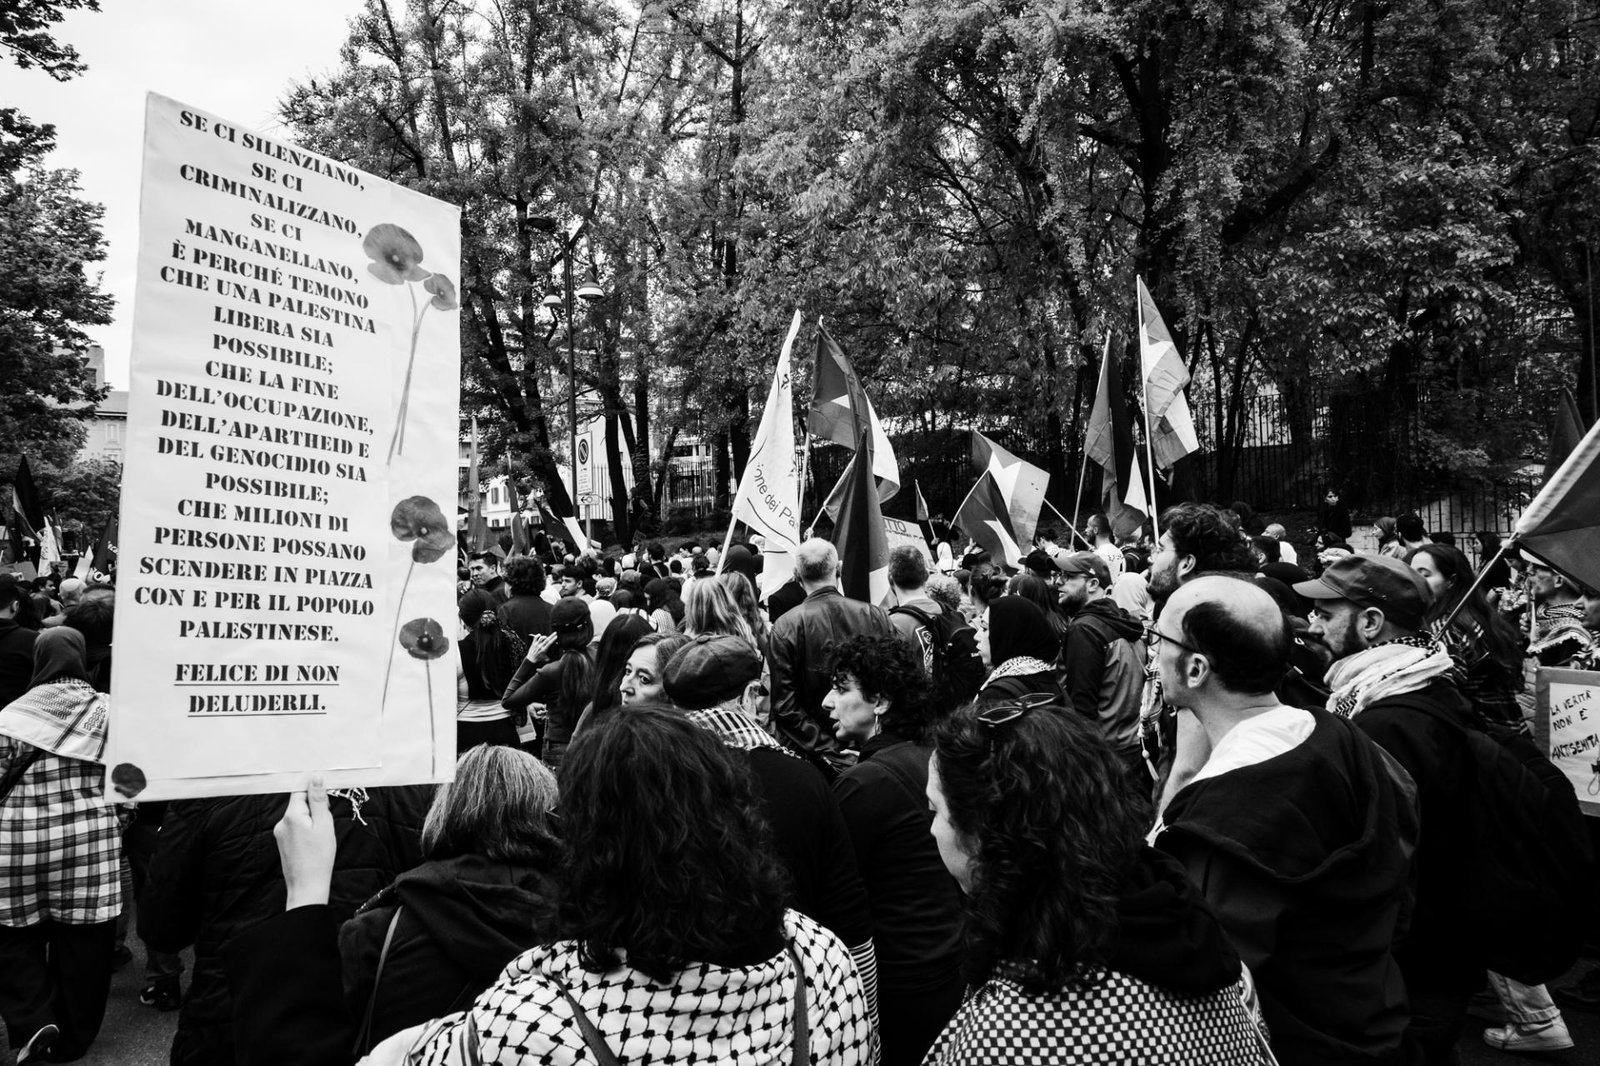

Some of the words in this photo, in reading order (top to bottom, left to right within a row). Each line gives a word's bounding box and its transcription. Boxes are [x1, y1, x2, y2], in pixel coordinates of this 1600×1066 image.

[180, 110, 207, 132] SE
[214, 123, 235, 143] CI
[242, 133, 364, 191] SILENZIANO,
[252, 162, 276, 183] SE
[282, 174, 302, 192] CI
[179, 163, 362, 239] CRIMINALIZZANO,
[251, 213, 275, 233] SE
[282, 224, 301, 241] CI
[186, 219, 358, 284] MANGANELLANO,
[172, 238, 185, 260] È
[193, 248, 282, 286] PERCHÉ
[289, 274, 368, 309] TEMONO
[160, 266, 209, 291] CHE
[217, 279, 261, 304] UNA
[268, 292, 375, 334] PALESTINA
[214, 306, 294, 338] LIBERA
[301, 327, 333, 347] SIA
[213, 334, 332, 374] POSSIBILE;
[205, 361, 252, 383] CHE
[259, 370, 284, 389] LA
[292, 377, 338, 400] FINE
[157, 380, 373, 435] DELL'OCCUPAZIONE,
[162, 409, 353, 454] DELL'APARTHEID
[359, 443, 369, 458] E
[158, 437, 204, 458] DEL
[210, 445, 330, 475] GENOCIDIO
[336, 463, 366, 482] SIA
[206, 473, 328, 505] POSSIBILE;
[178, 499, 226, 520] CHE
[234, 505, 321, 529] MILIONI
[329, 515, 348, 532] DI
[764, 493, 782, 513] dei
[778, 506, 797, 528] Pa
[154, 527, 265, 552] PERSONE
[273, 537, 366, 561] POSSANO
[140, 557, 267, 581] SCENDERE
[274, 566, 298, 583] IN
[305, 568, 373, 589] PIAZZA
[135, 587, 185, 606] CON
[193, 590, 207, 607] E
[215, 591, 261, 610] PER
[268, 594, 290, 611] IL
[297, 596, 374, 615] POPOLO
[180, 620, 339, 642] PALESTINESE.
[176, 664, 257, 682] FELICE
[265, 665, 289, 681] DI
[297, 665, 339, 681] NON
[189, 694, 326, 712] DELUDERLI.
[1550, 704, 1561, 716] LA
[1553, 715, 1573, 731] NON
